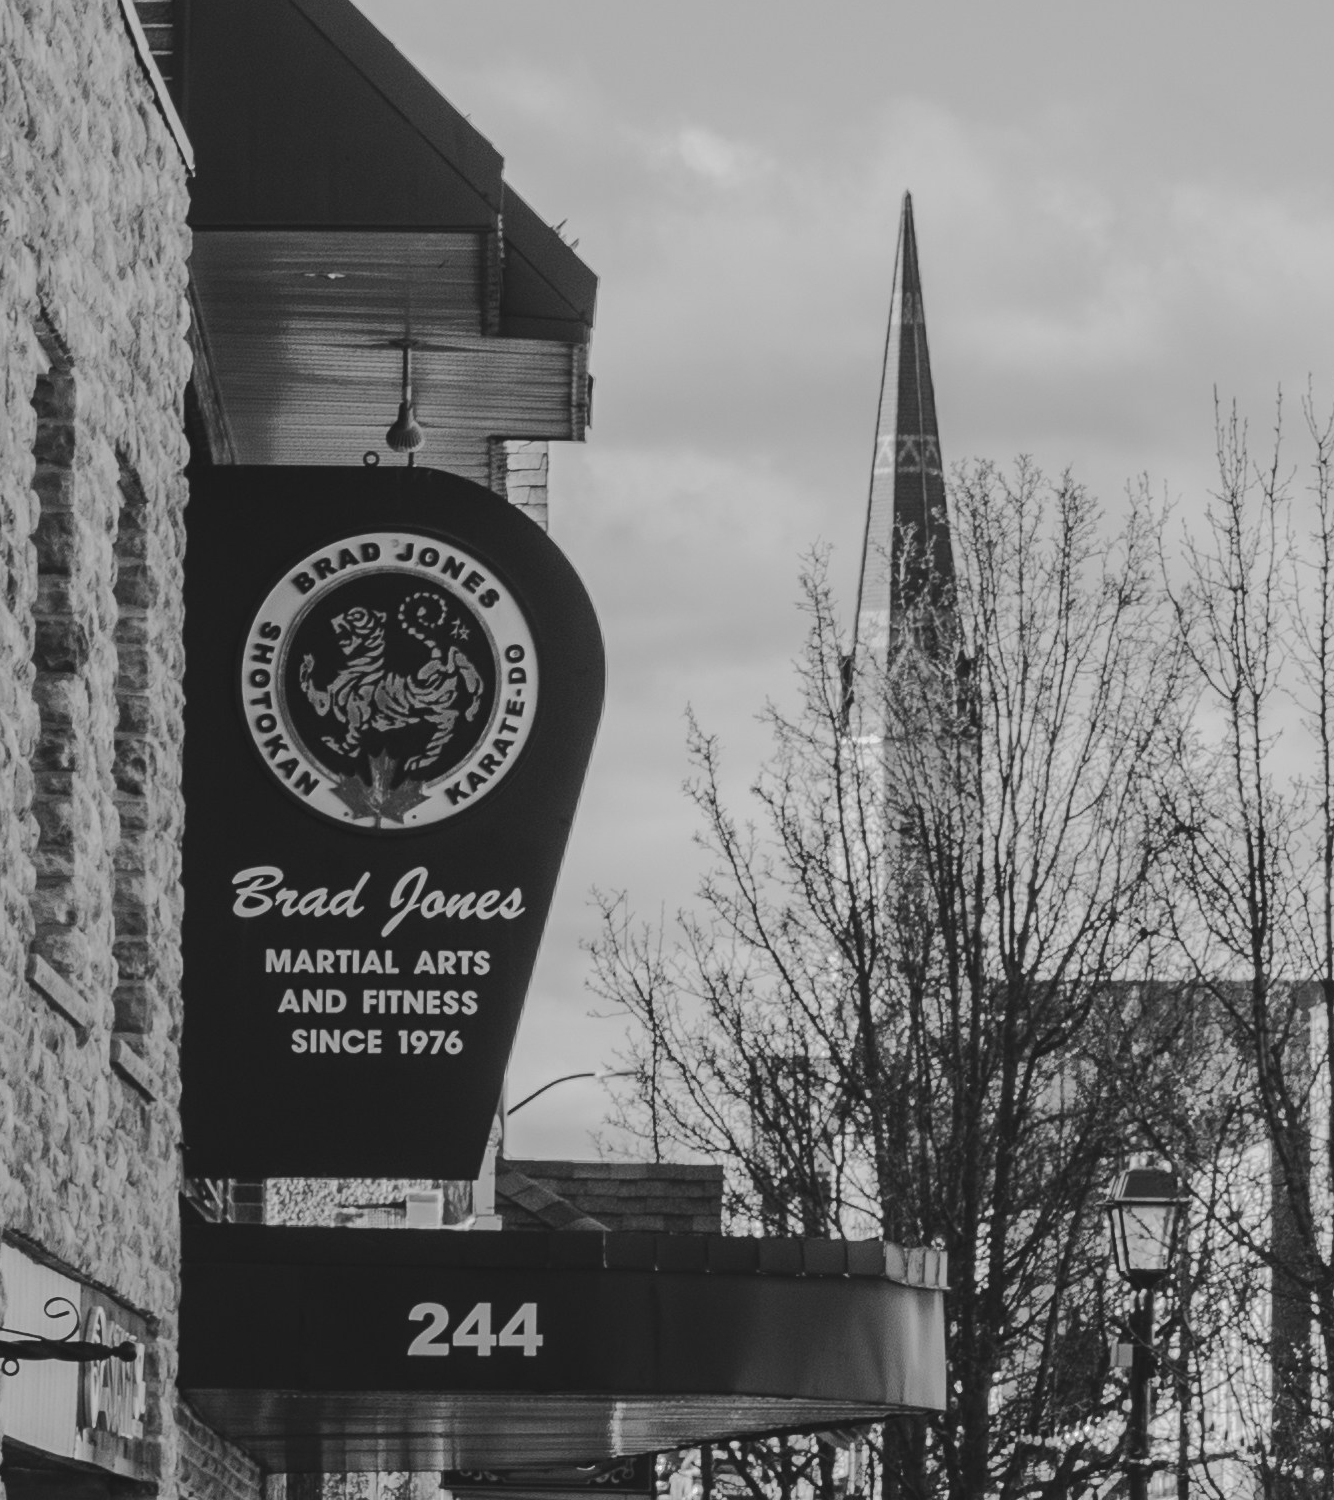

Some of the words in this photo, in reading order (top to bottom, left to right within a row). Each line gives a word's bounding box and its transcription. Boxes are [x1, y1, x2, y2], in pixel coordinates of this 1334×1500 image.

[291, 541, 381, 596] BRAD
[395, 542, 501, 609] JONES
[249, 620, 321, 798] SHOTOKAN
[444, 643, 527, 806] KARATE-DO
[231, 865, 371, 919] Brad
[380, 866, 526, 938] Jones
[265, 948, 400, 975] MARTIAL
[413, 950, 491, 976] ARTS
[277, 988, 348, 1014] AND
[362, 989, 479, 1016] FITNESS
[290, 1028, 383, 1054] SINCE
[397, 1030, 464, 1055] 1976
[407, 1302, 544, 1357] 244
